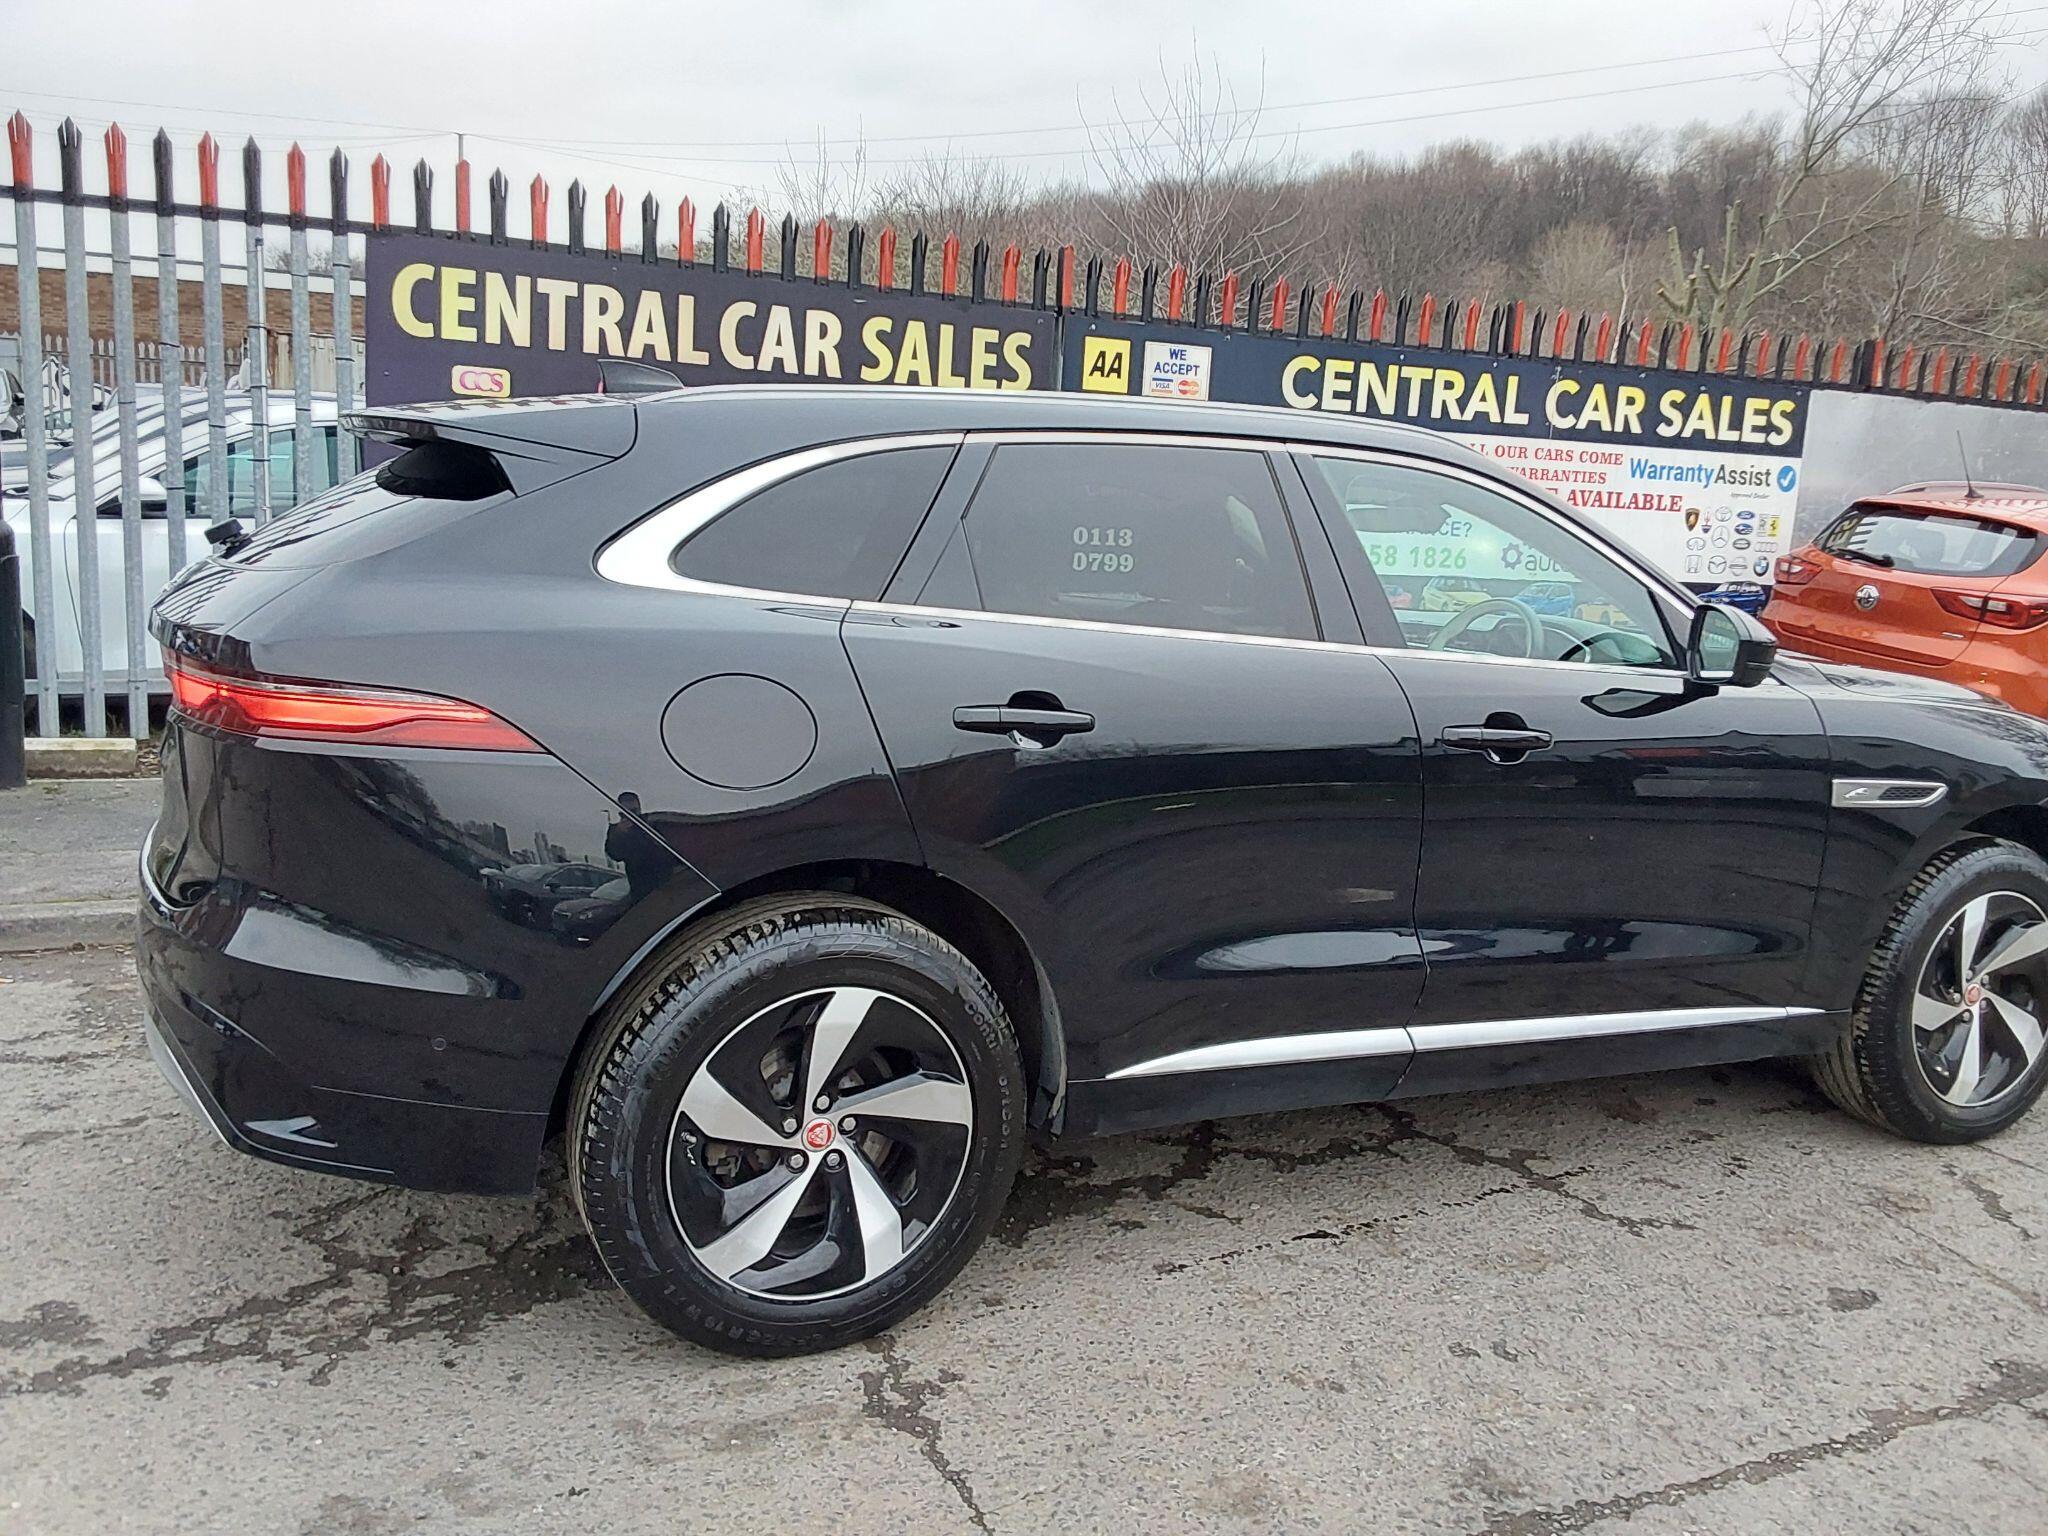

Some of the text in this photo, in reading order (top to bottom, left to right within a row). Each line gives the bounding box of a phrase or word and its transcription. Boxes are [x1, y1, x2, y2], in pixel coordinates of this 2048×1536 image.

[391, 262, 1032, 391] CENTRAL CAR SALES
[1088, 350, 1123, 379] AA
[1169, 347, 1187, 361] WE
[1153, 362, 1200, 377] ACCEPT
[1281, 355, 1796, 446] CENTRAL CAR SALES
[1494, 444, 1529, 459] OUR
[1534, 447, 1574, 462] CARS
[1579, 450, 1624, 466] COME
[1507, 466, 1607, 485] ARRANTIES
[1566, 488, 1683, 512] AVAILABLE
[1073, 526, 1134, 547] 0113
[1072, 551, 1135, 573] 0799
[1410, 545, 1467, 570] 1826
